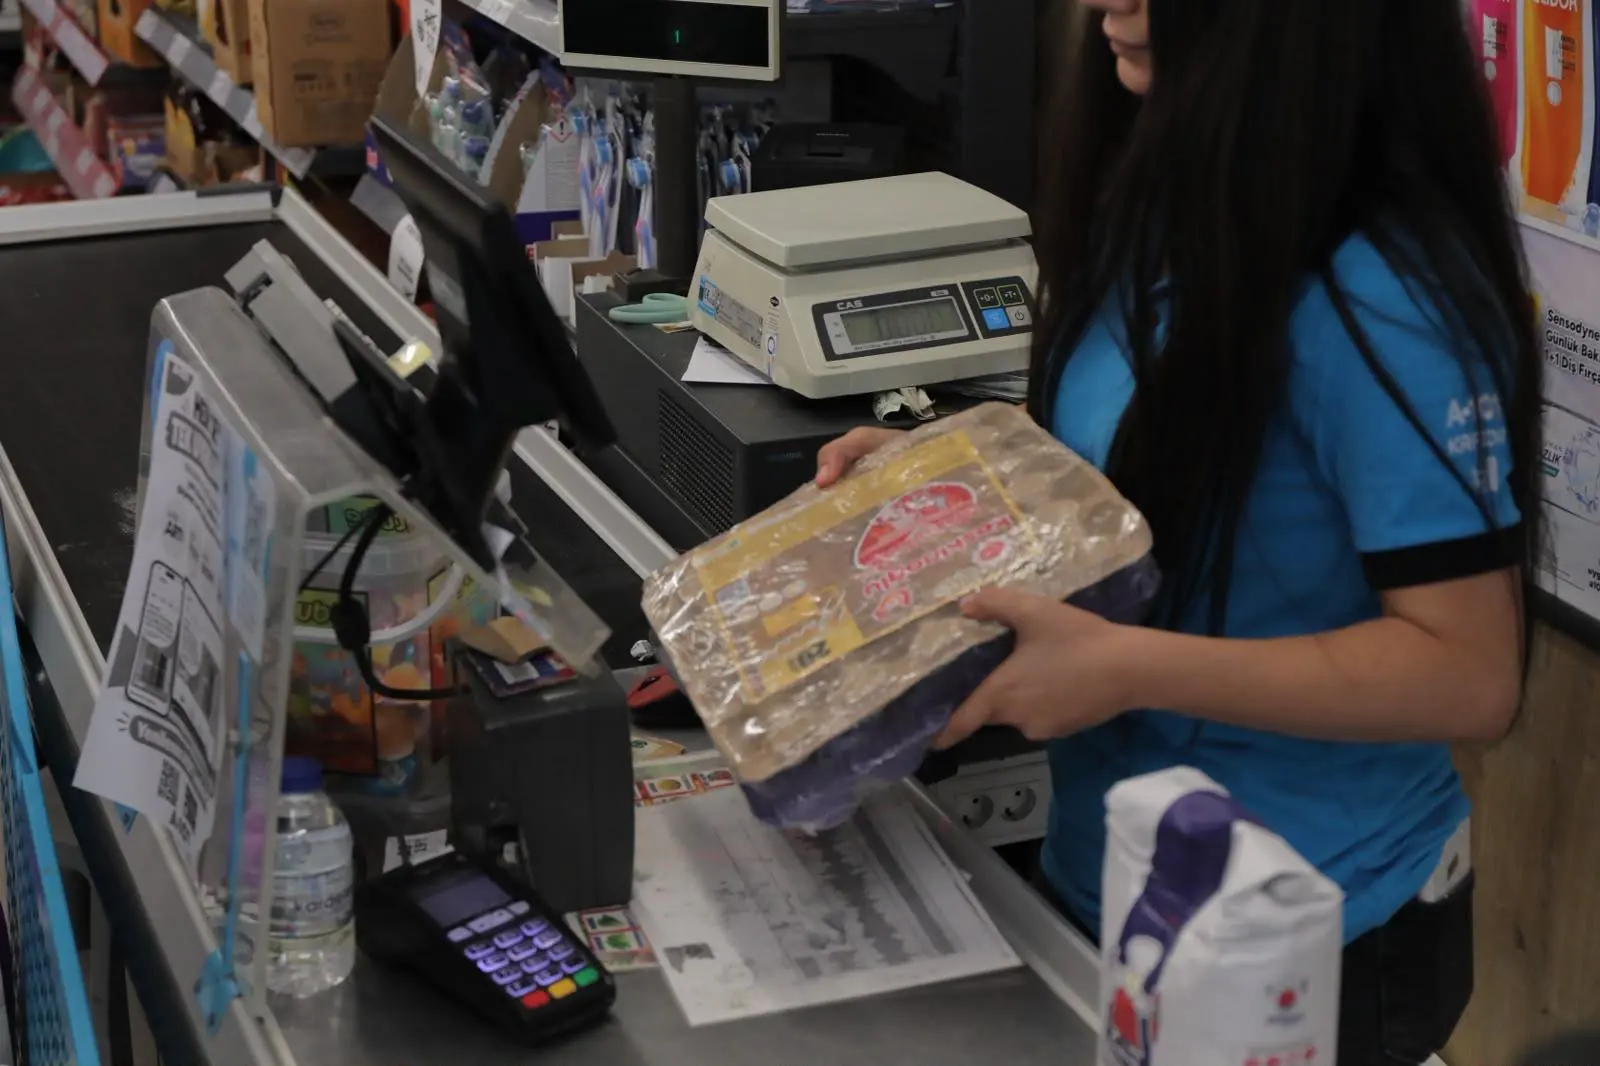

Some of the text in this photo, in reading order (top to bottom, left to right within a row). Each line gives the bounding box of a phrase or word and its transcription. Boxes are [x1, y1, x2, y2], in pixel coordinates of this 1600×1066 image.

[836, 299, 863, 311] CAS
[1547, 309, 1600, 341] Sensodyne
[1545, 330, 1600, 363] Günlük Bak
[1561, 355, 1577, 375] Diş
